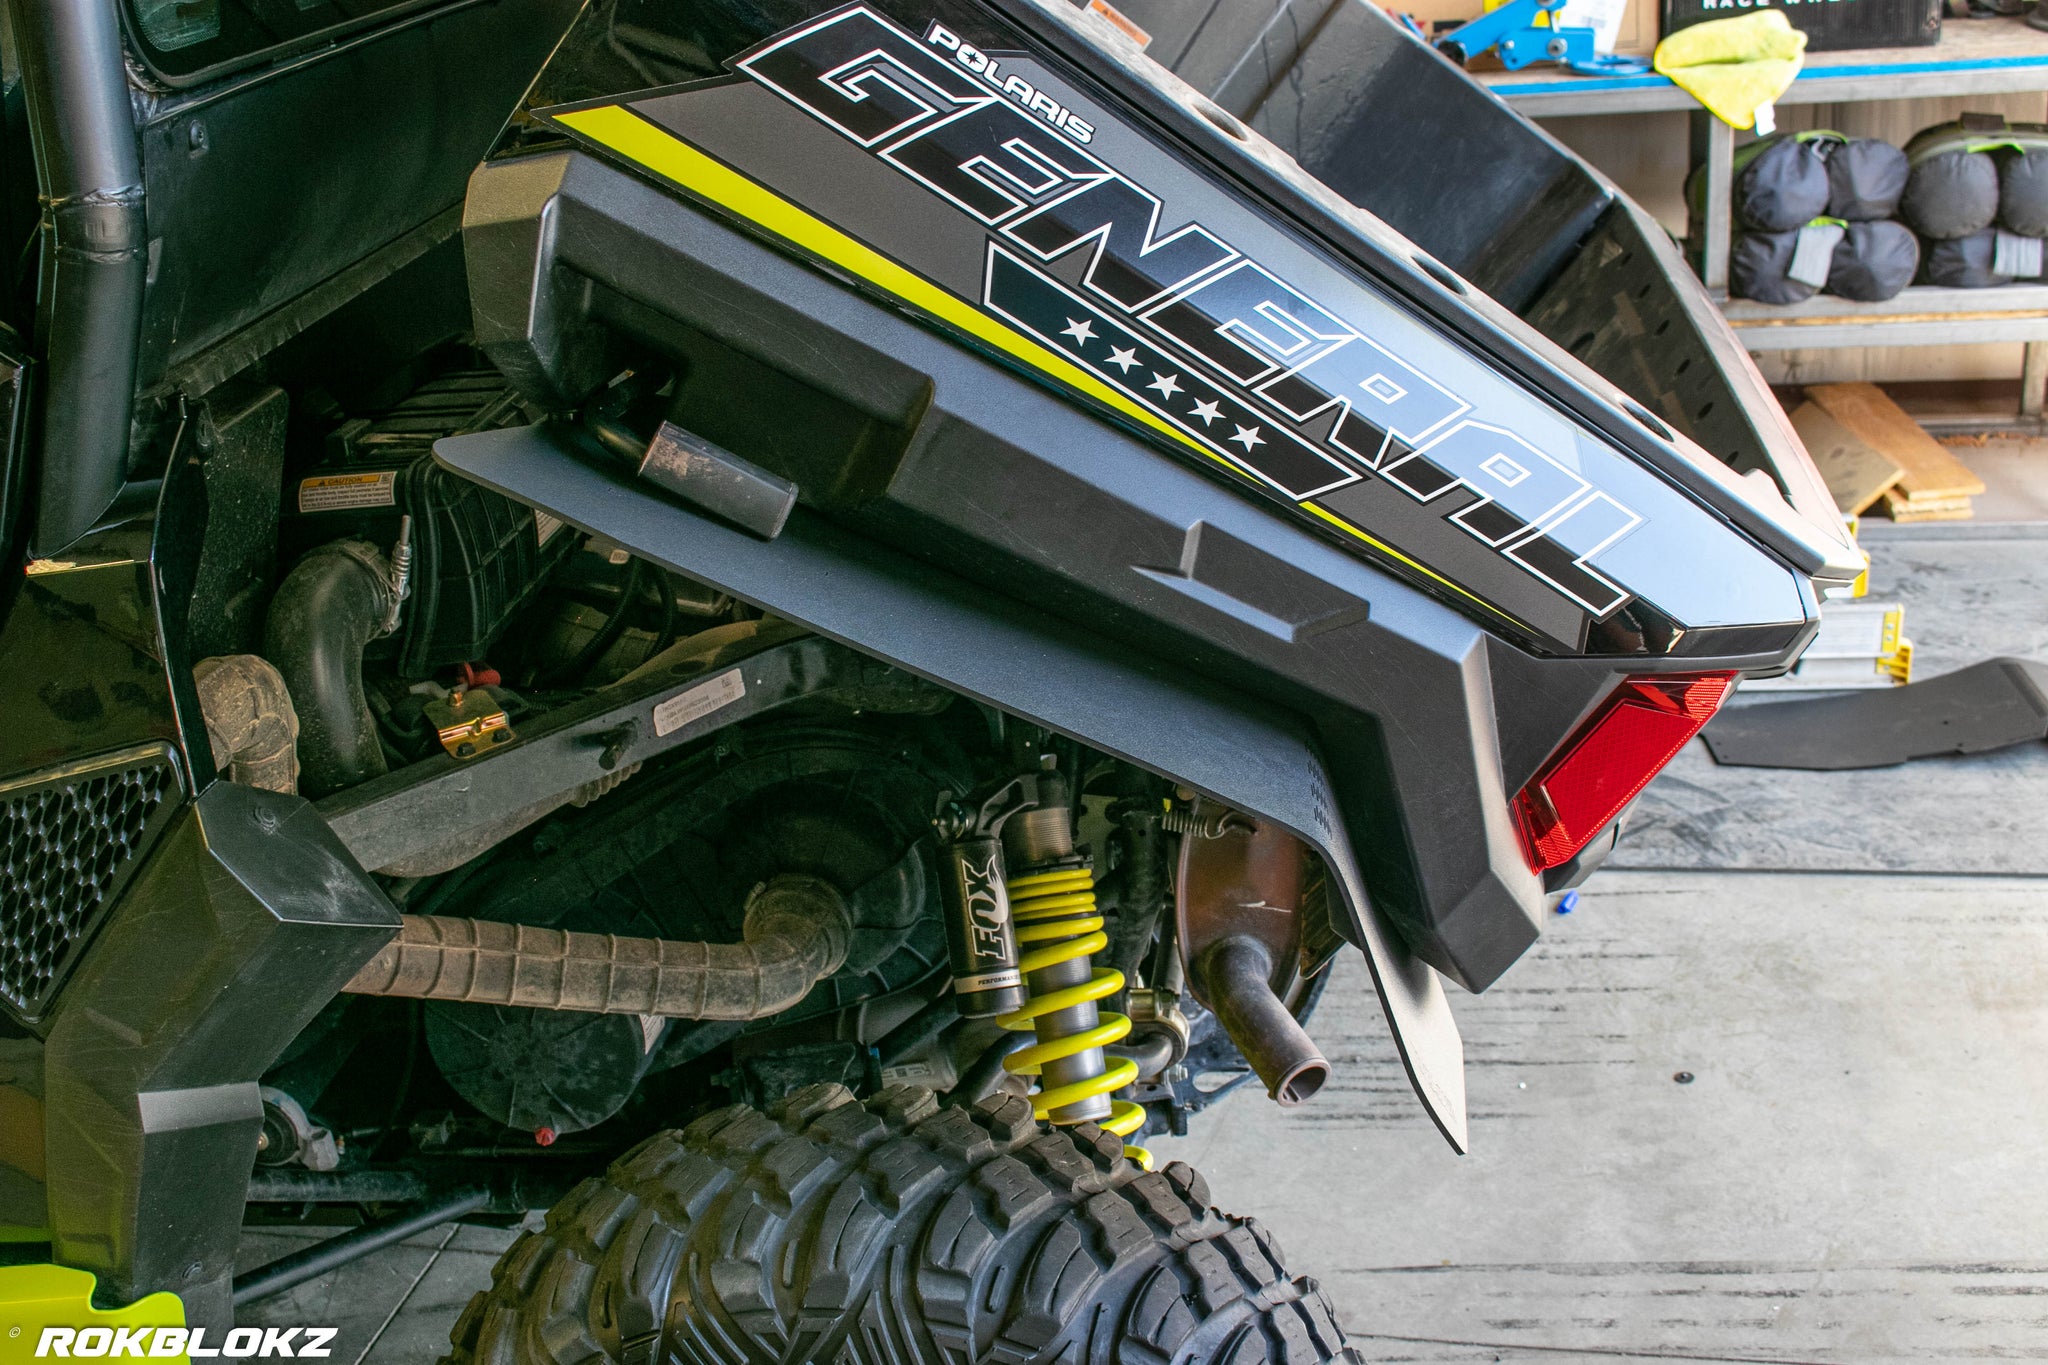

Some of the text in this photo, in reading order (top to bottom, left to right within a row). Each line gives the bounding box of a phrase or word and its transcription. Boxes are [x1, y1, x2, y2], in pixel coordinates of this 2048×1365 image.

[928, 24, 1096, 144] POLARIS
[737, 5, 1644, 617] GENERAL
[328, 476, 363, 485] CAUTION
[961, 854, 1009, 960] FOX
